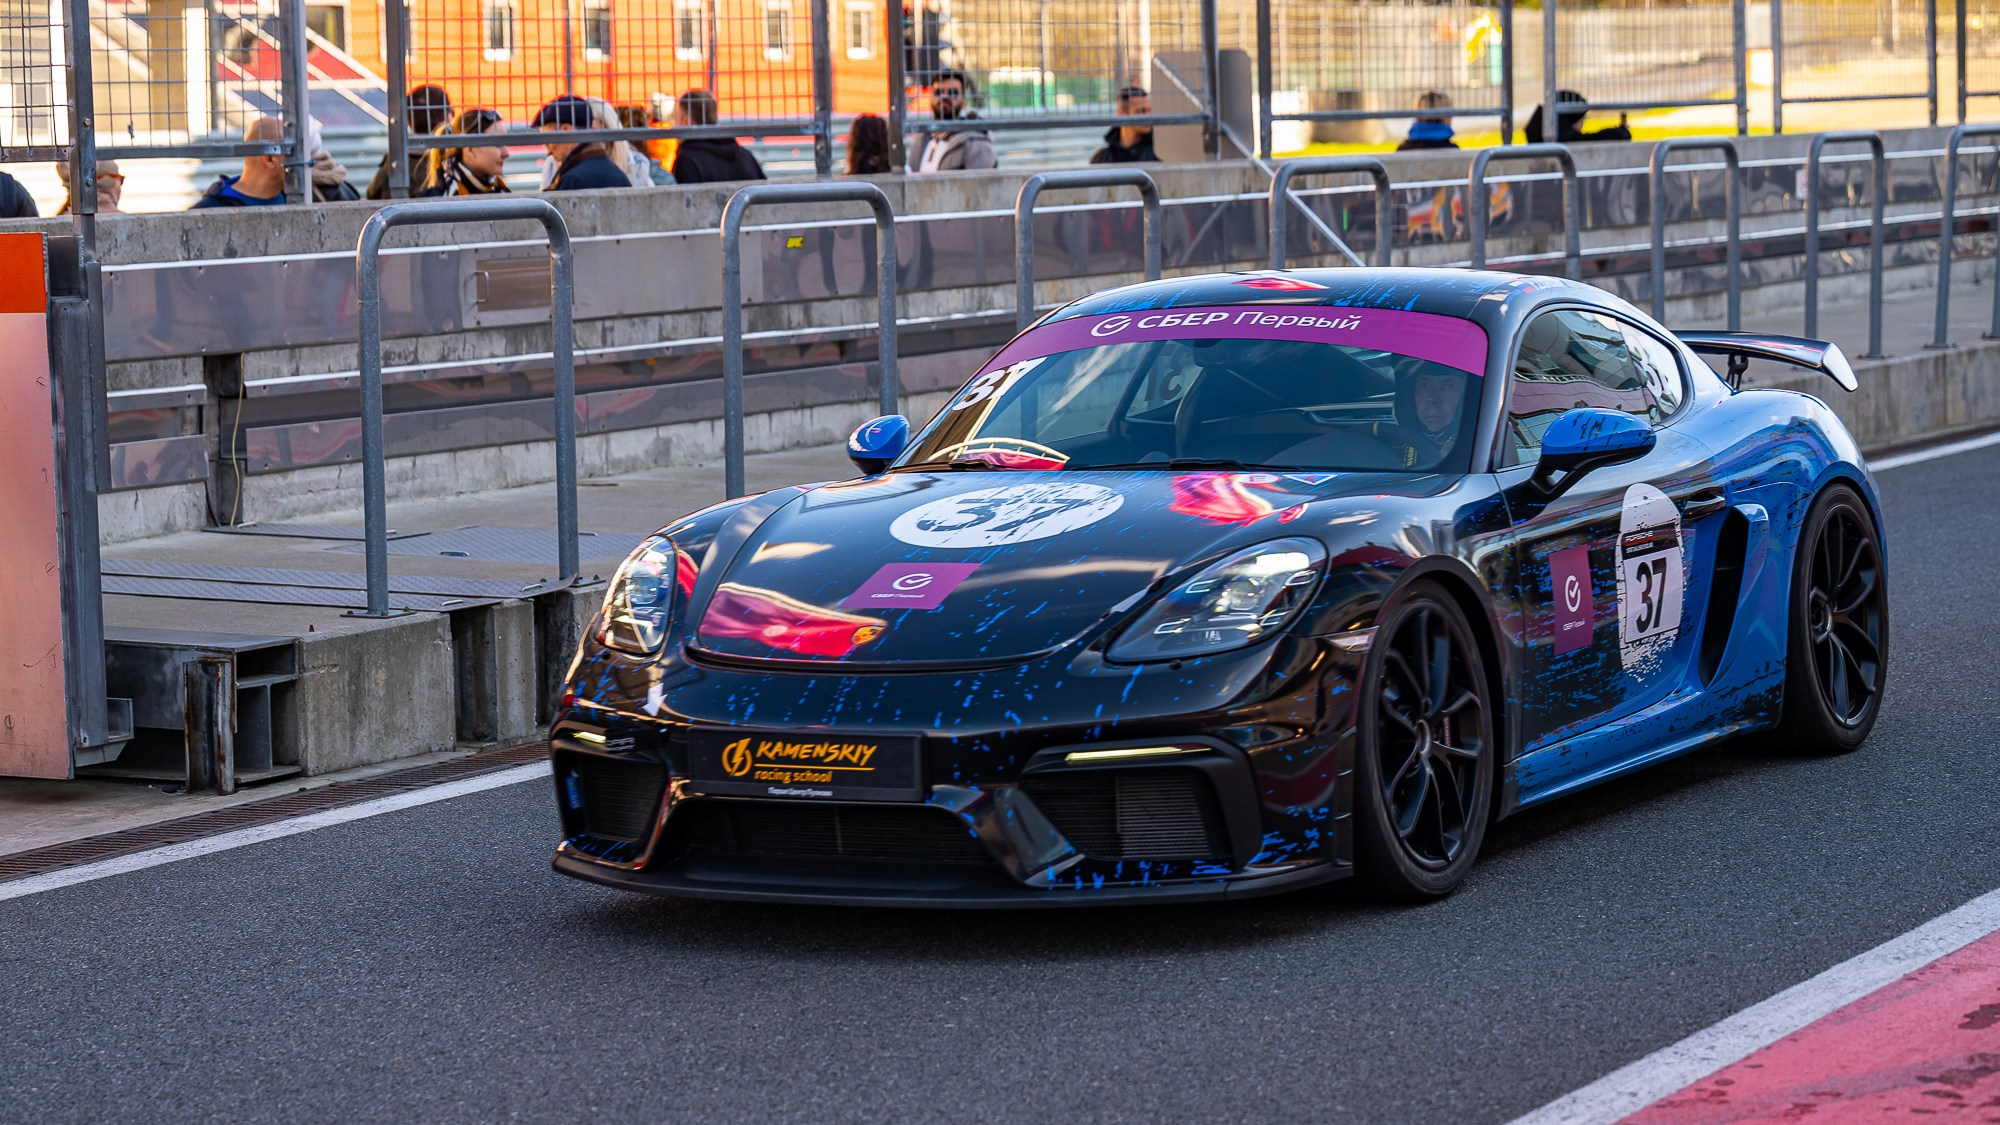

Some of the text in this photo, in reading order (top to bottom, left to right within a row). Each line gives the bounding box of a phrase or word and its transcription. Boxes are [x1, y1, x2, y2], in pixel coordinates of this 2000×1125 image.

[1137, 311, 1362, 330] СБЕР Первый
[952, 357, 1048, 411] 37
[915, 498, 1096, 532] 37
[1636, 557, 1667, 633] 37
[756, 741, 878, 766] KAMENSKIY
[754, 768, 833, 784] racing school
